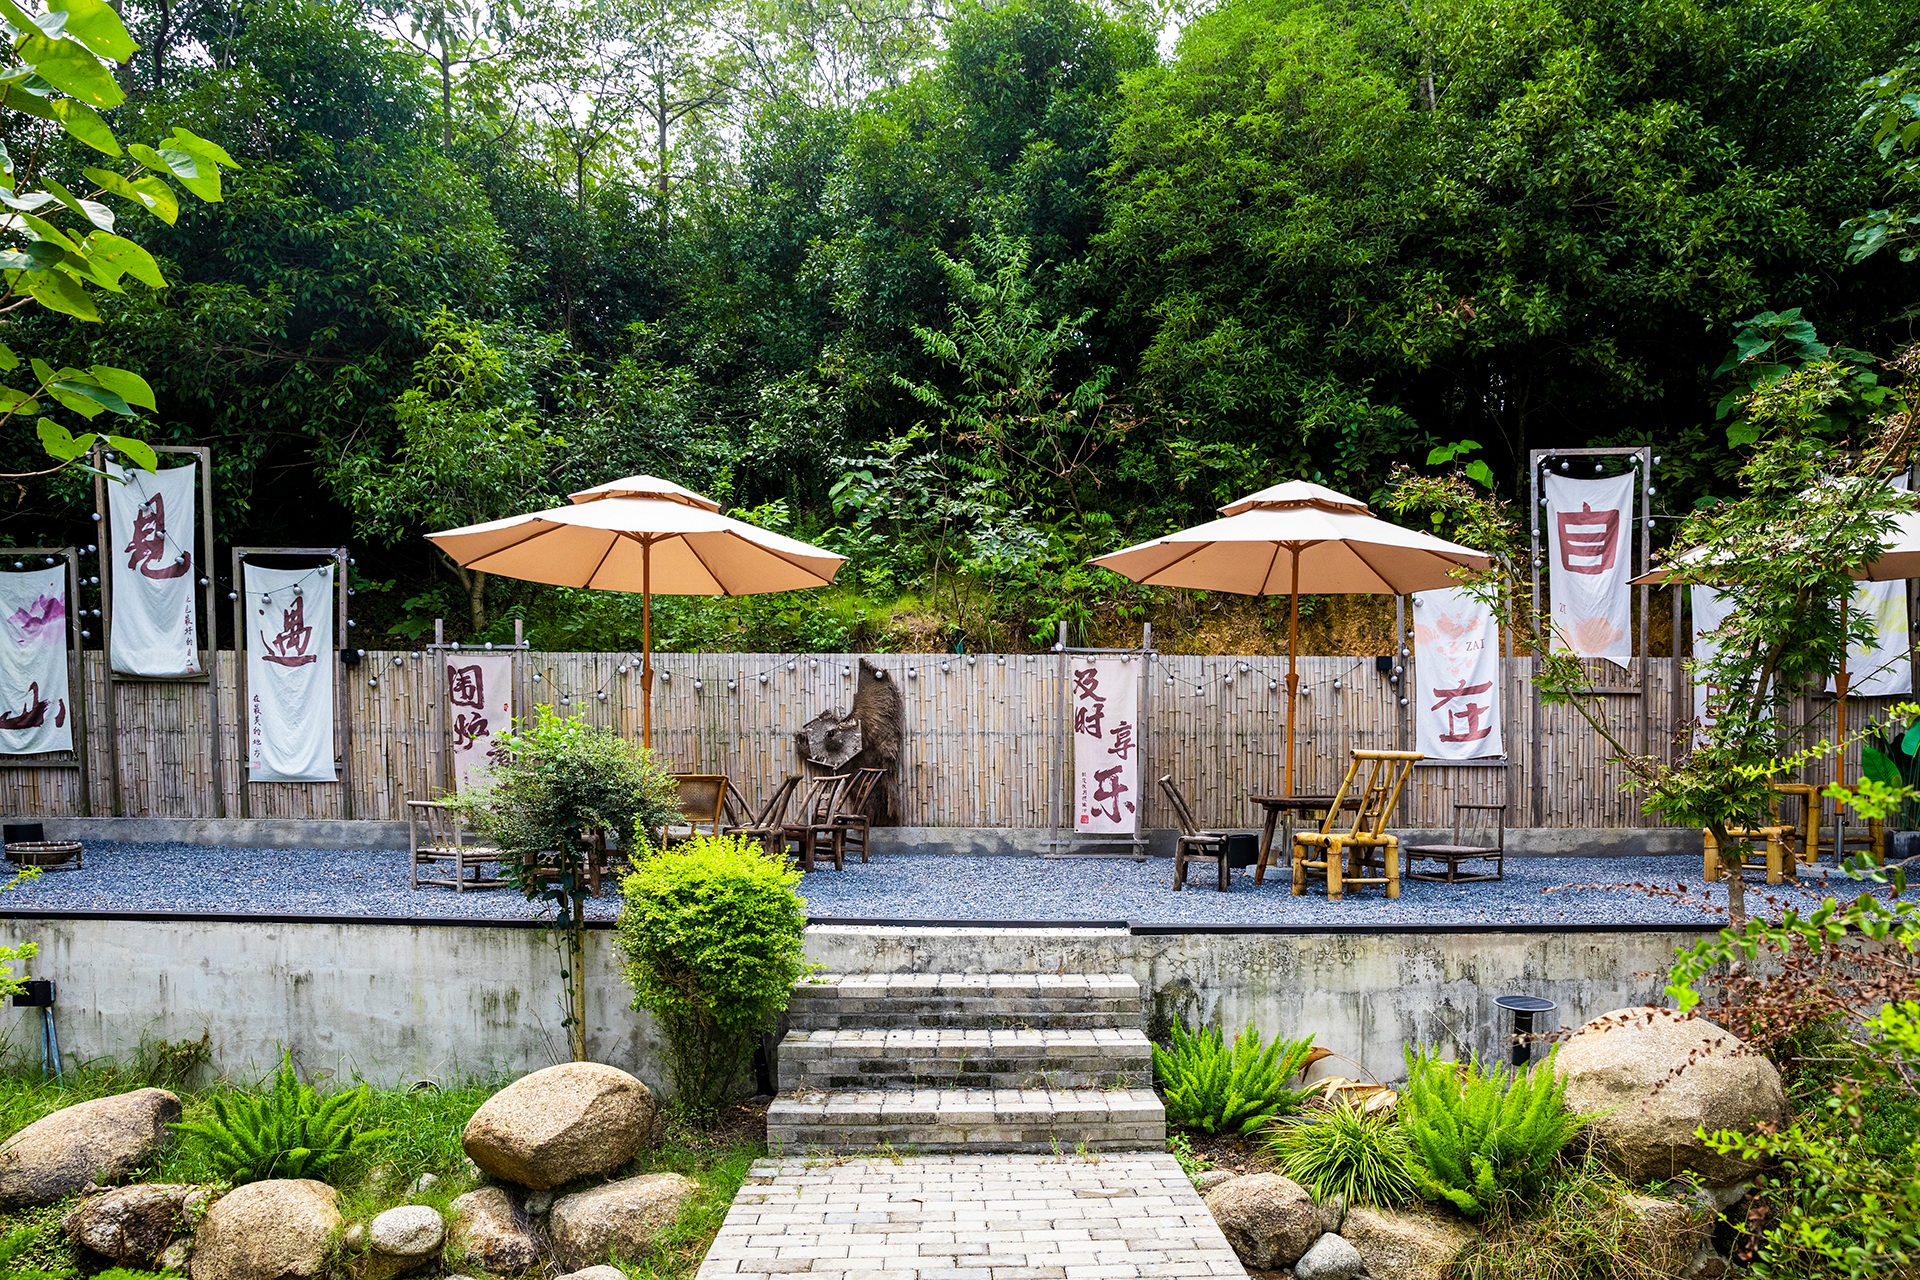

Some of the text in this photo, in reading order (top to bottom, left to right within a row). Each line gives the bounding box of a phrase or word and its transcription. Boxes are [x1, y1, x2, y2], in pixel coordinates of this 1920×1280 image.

[1557, 502, 1620, 574] 自
[258, 595, 318, 668] 遇
[1465, 638, 1485, 652] ZAI
[447, 664, 490, 753] 围炉
[1073, 667, 1107, 739] 及时
[1430, 679, 1493, 743] 在
[1091, 720, 1136, 824] 享乐
